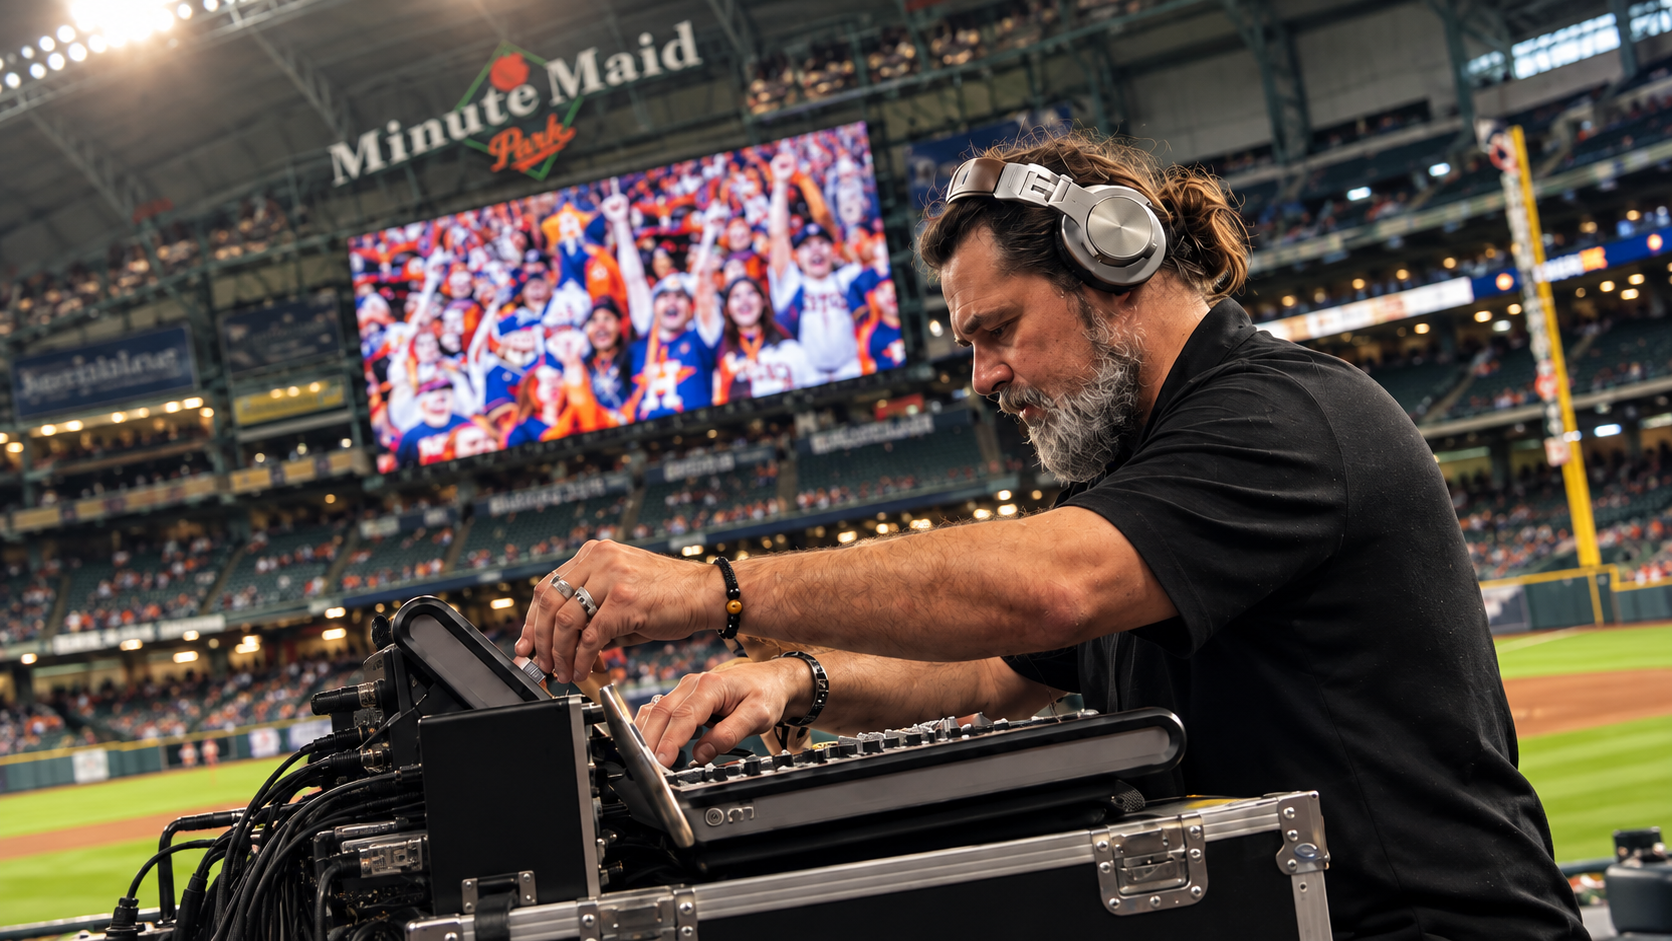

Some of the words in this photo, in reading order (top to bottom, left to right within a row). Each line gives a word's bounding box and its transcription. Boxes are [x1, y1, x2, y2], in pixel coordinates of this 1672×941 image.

[327, 83, 540, 188] Minute
[546, 20, 703, 108] Maid
[488, 113, 577, 173] Park
